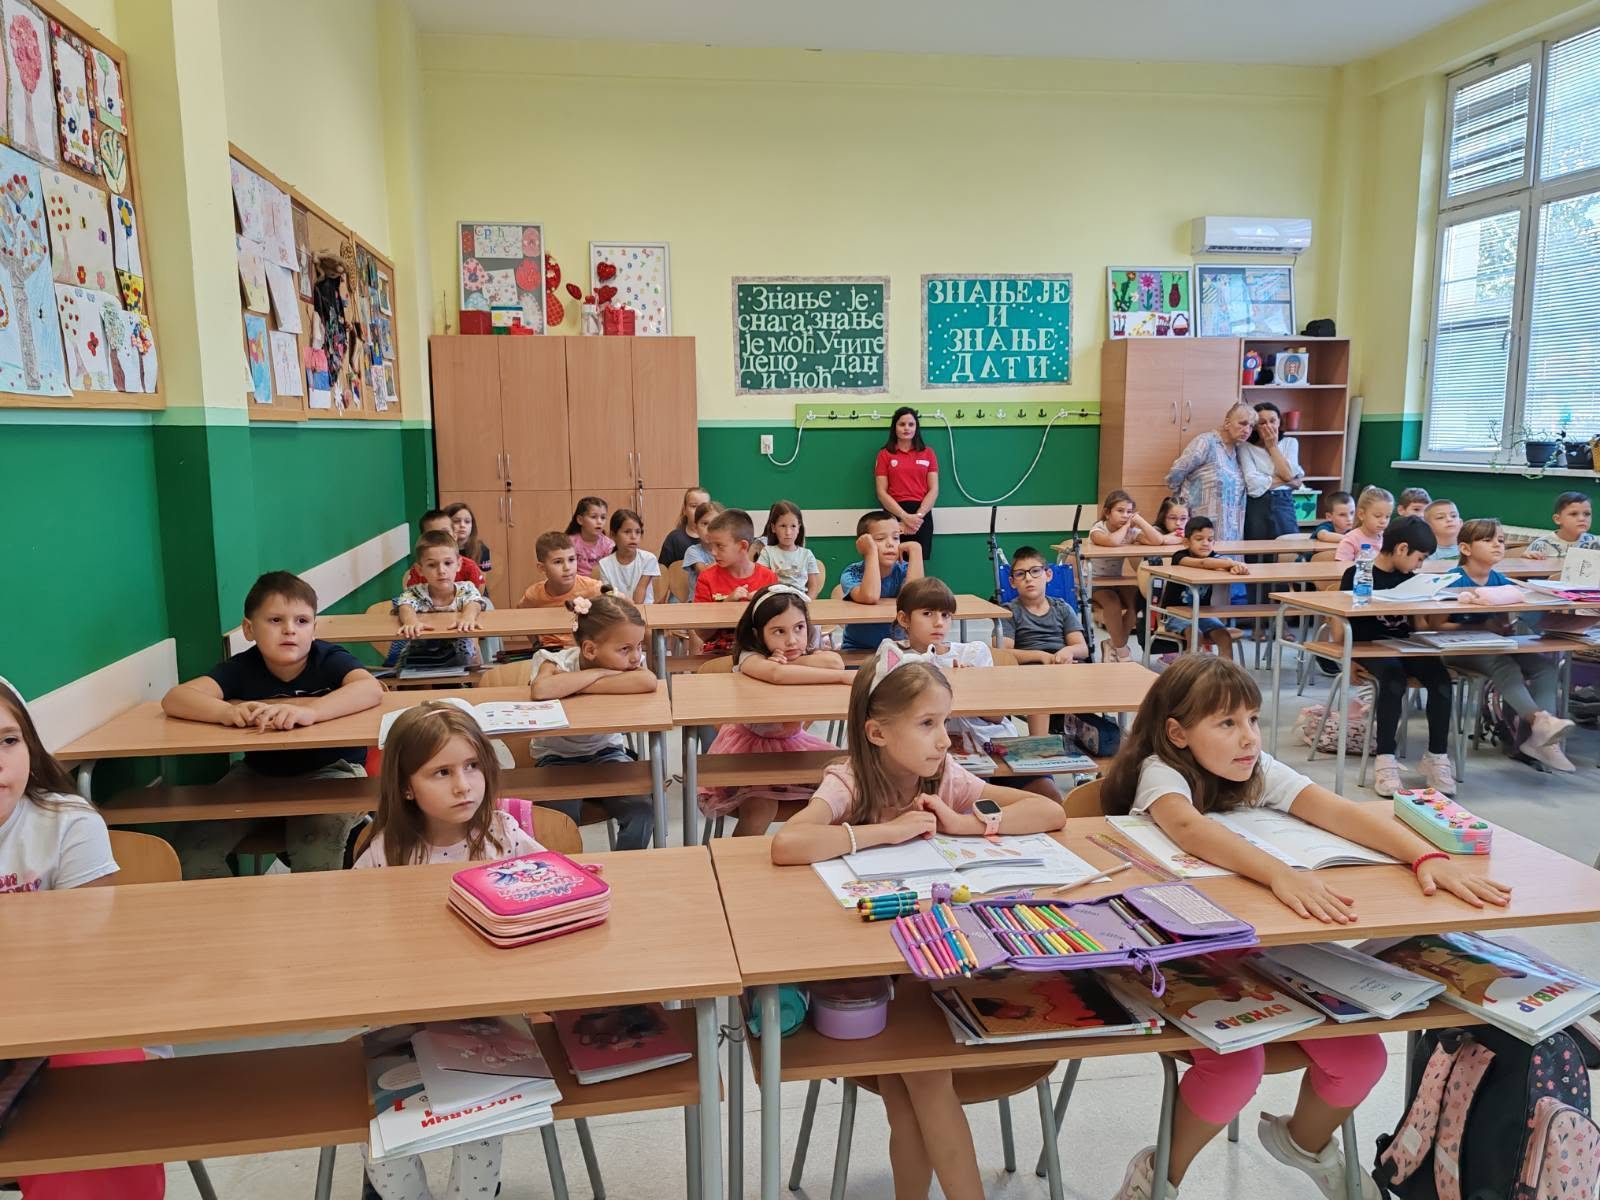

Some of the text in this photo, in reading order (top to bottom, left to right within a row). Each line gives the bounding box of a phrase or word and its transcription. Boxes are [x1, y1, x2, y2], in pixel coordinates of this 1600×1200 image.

[752, 285, 869, 312] Знање је
[928, 280, 1071, 304] ЗНАЊЕ ЈЕ
[986, 304, 1009, 327] И
[742, 329, 765, 356] је
[817, 330, 885, 355] Учите
[947, 327, 1056, 352] ЗНАЊЕ
[740, 353, 880, 375] децо дан
[951, 352, 1049, 382] ДАТИ
[761, 372, 777, 389] и
[1213, 1004, 1293, 1030] БУКВАР
